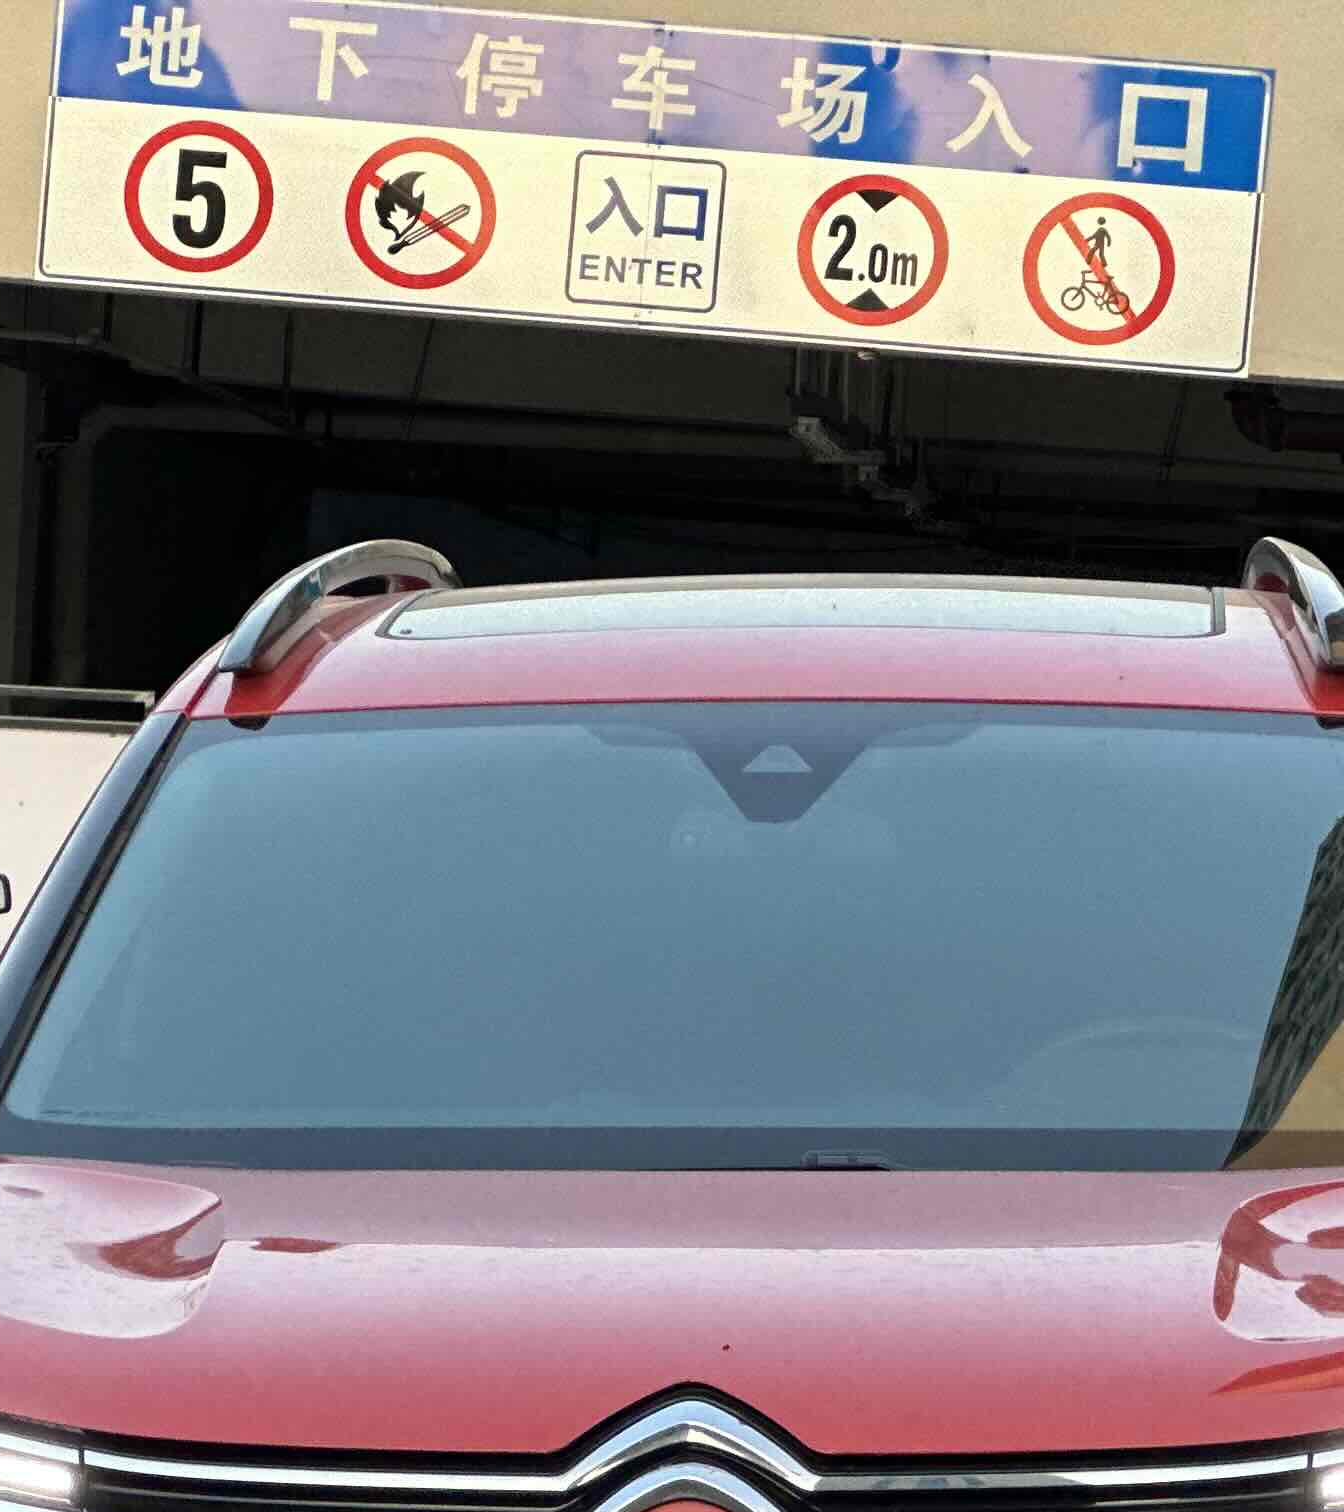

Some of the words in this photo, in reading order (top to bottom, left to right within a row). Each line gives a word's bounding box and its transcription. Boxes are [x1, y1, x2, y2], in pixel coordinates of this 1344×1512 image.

[116, 6, 1208, 173] 地下停车场入口
[172, 148, 228, 249] 5
[584, 176, 707, 242] 入口
[578, 253, 704, 290] ENTER
[823, 214, 918, 287] 2.0m
